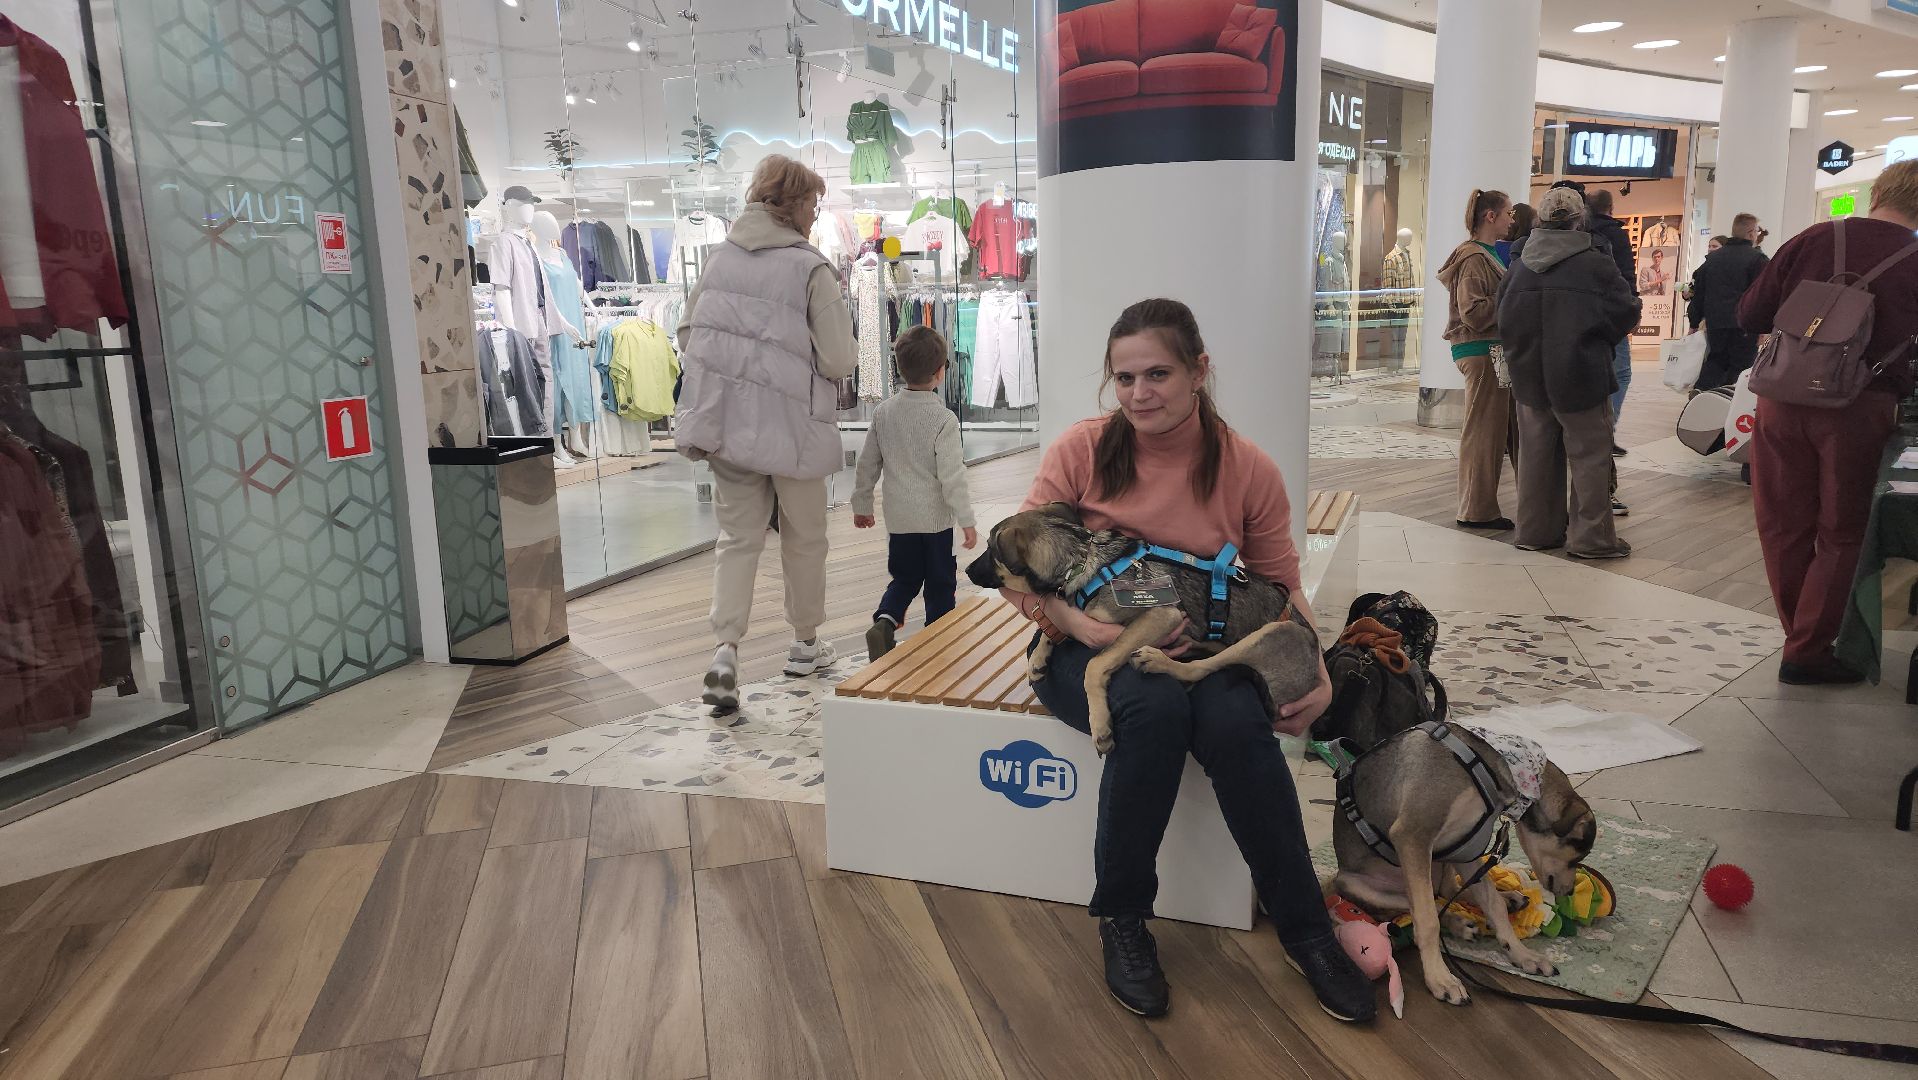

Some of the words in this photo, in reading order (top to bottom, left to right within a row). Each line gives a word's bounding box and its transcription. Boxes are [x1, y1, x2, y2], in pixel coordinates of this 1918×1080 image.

[1325, 145, 1356, 161] ОДЕЖДА
[1573, 131, 1656, 167] СУДАРЬ
[1823, 160, 1849, 168] BADEN
[986, 757, 1022, 785] Wi
[1036, 764, 1066, 791] Fi
